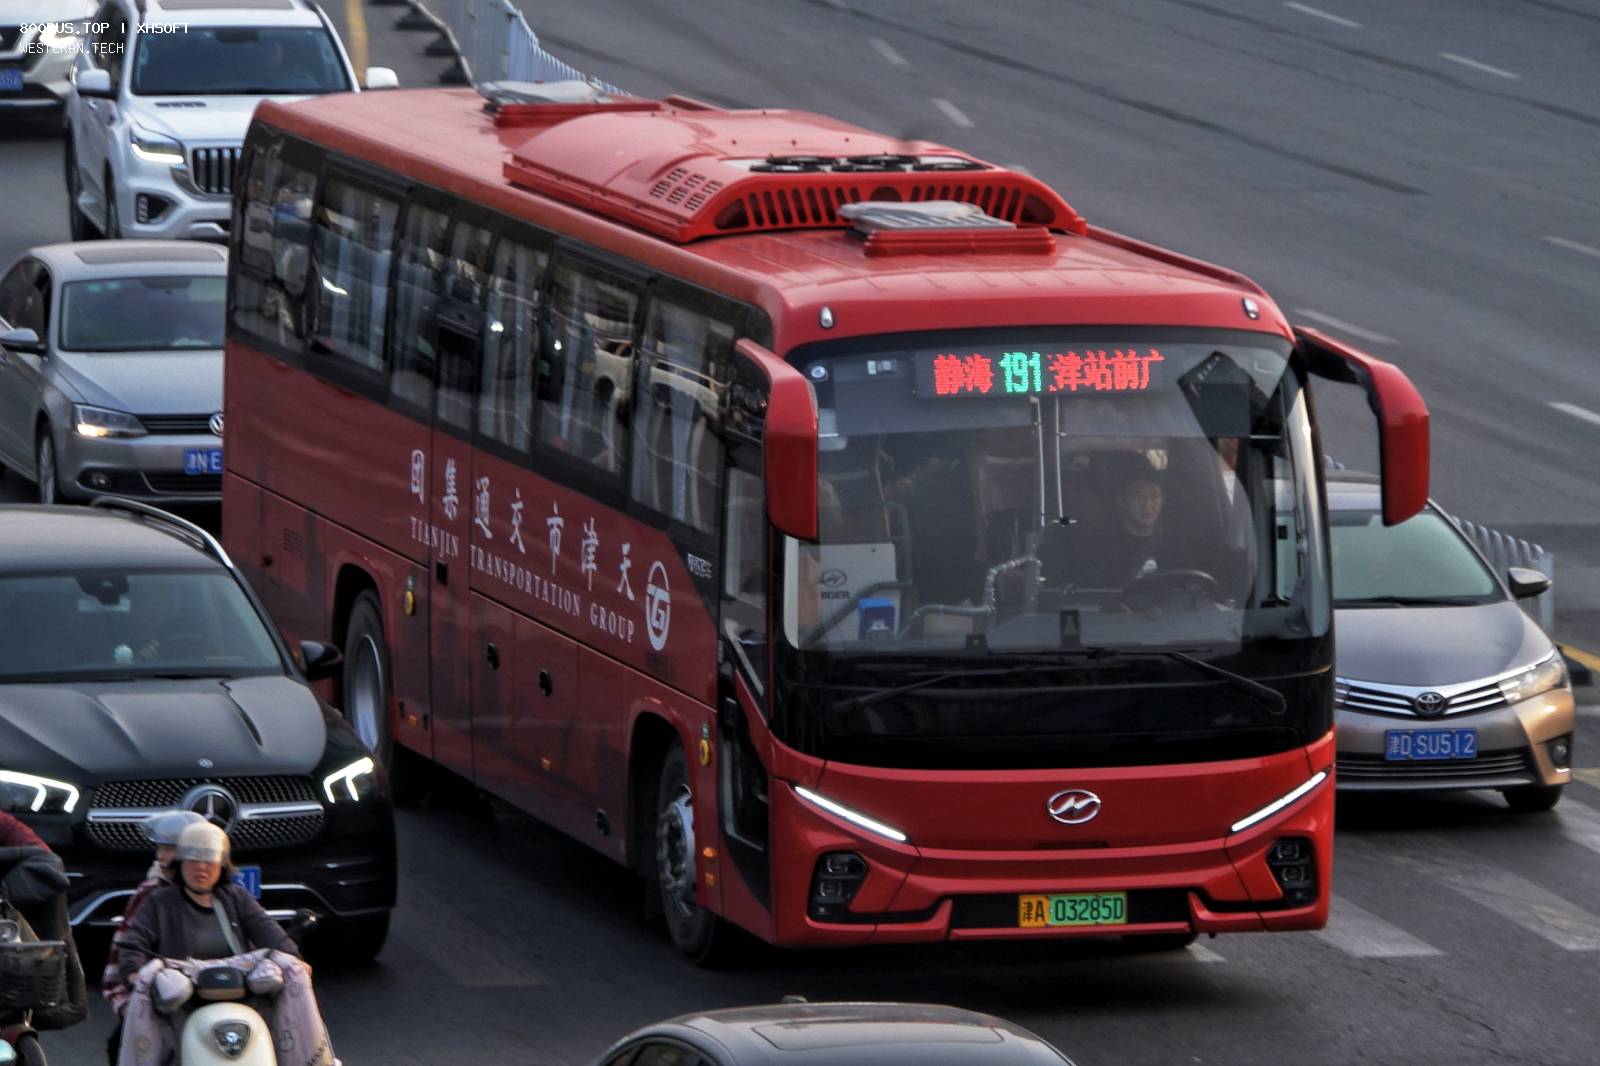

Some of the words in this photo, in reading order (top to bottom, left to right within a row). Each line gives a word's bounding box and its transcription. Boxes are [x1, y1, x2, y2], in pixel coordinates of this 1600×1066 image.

[933, 353, 993, 395] 静海
[999, 351, 1042, 393] 191
[410, 516, 459, 557] TIANJIN
[470, 544, 582, 617] TRANSPORTATION
[590, 602, 635, 643] GROUP
